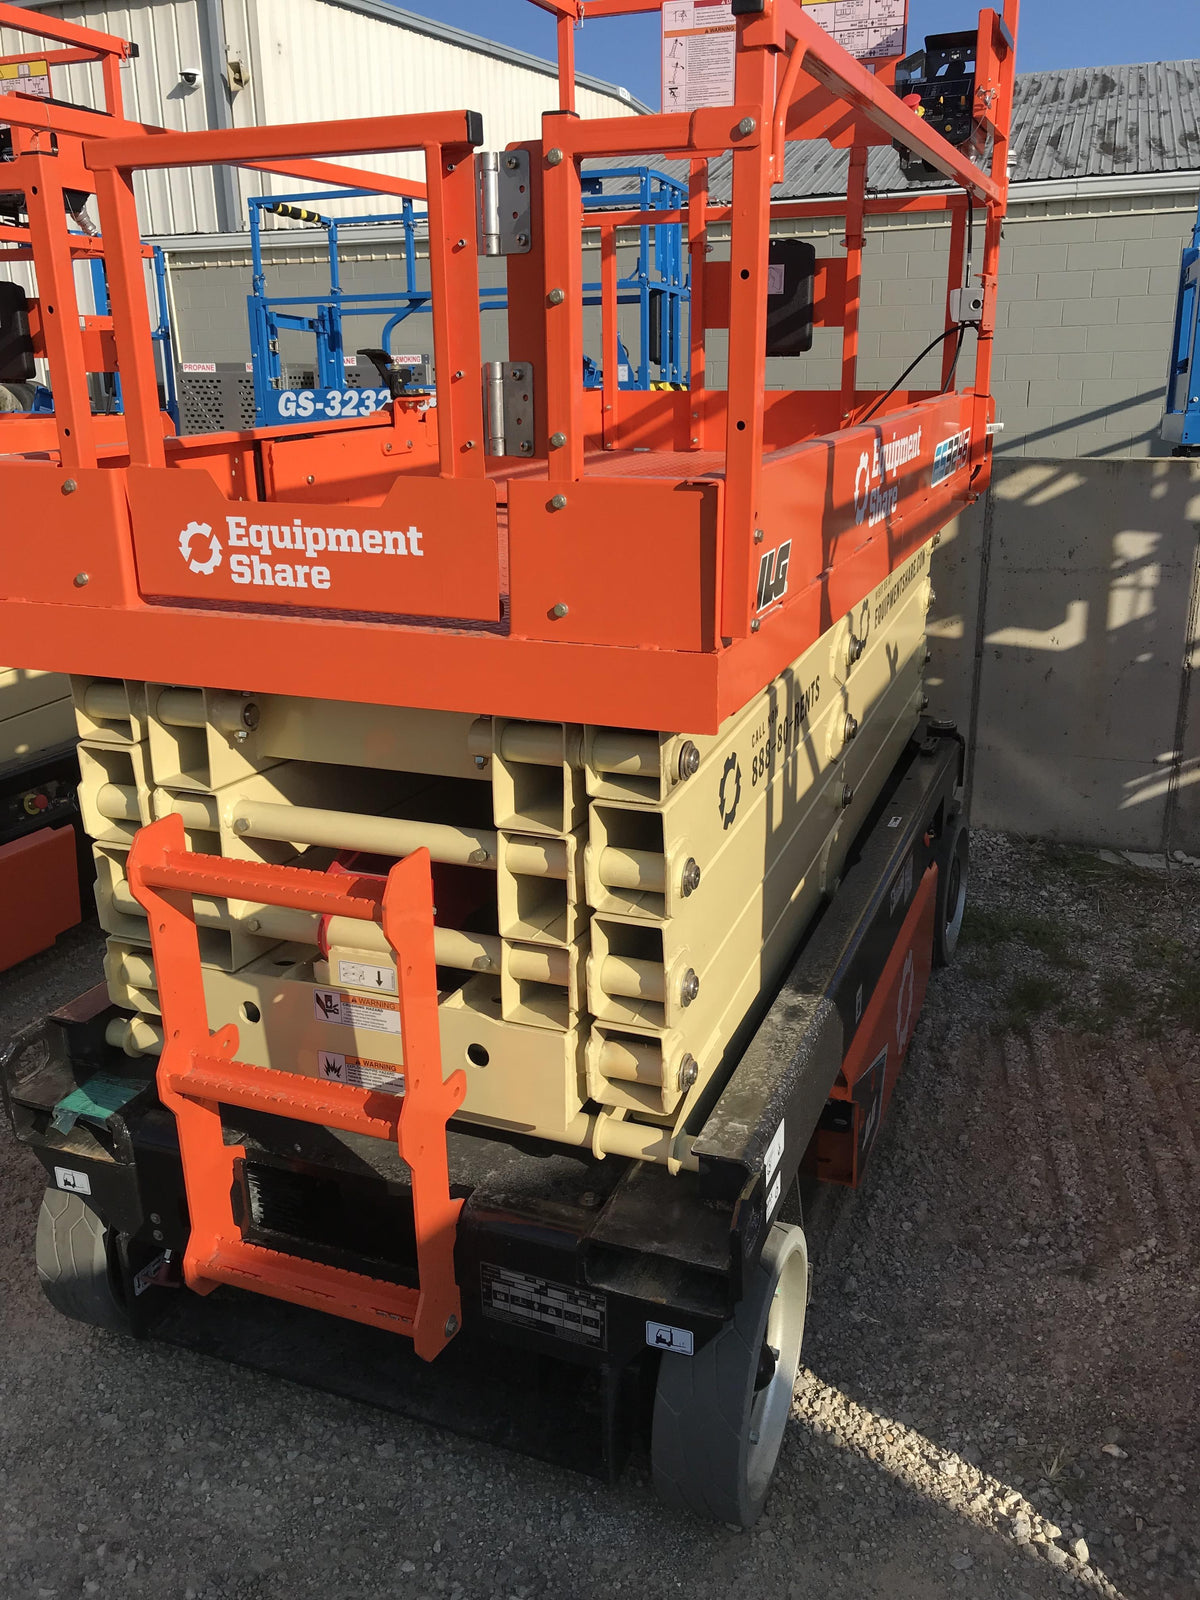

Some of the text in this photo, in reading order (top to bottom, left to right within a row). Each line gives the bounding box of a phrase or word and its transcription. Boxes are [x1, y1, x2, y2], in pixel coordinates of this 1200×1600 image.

[183, 363, 215, 371] PROPANE
[871, 425, 922, 483] Equipment
[868, 486, 898, 527] Share
[225, 516, 424, 558] Equipment
[229, 554, 331, 590] Share
[752, 675, 820, 787] 888-80-RENTS
[752, 722, 765, 748] CALL
[359, 998, 396, 1010] WARNING
[363, 1060, 396, 1072] WARNING
